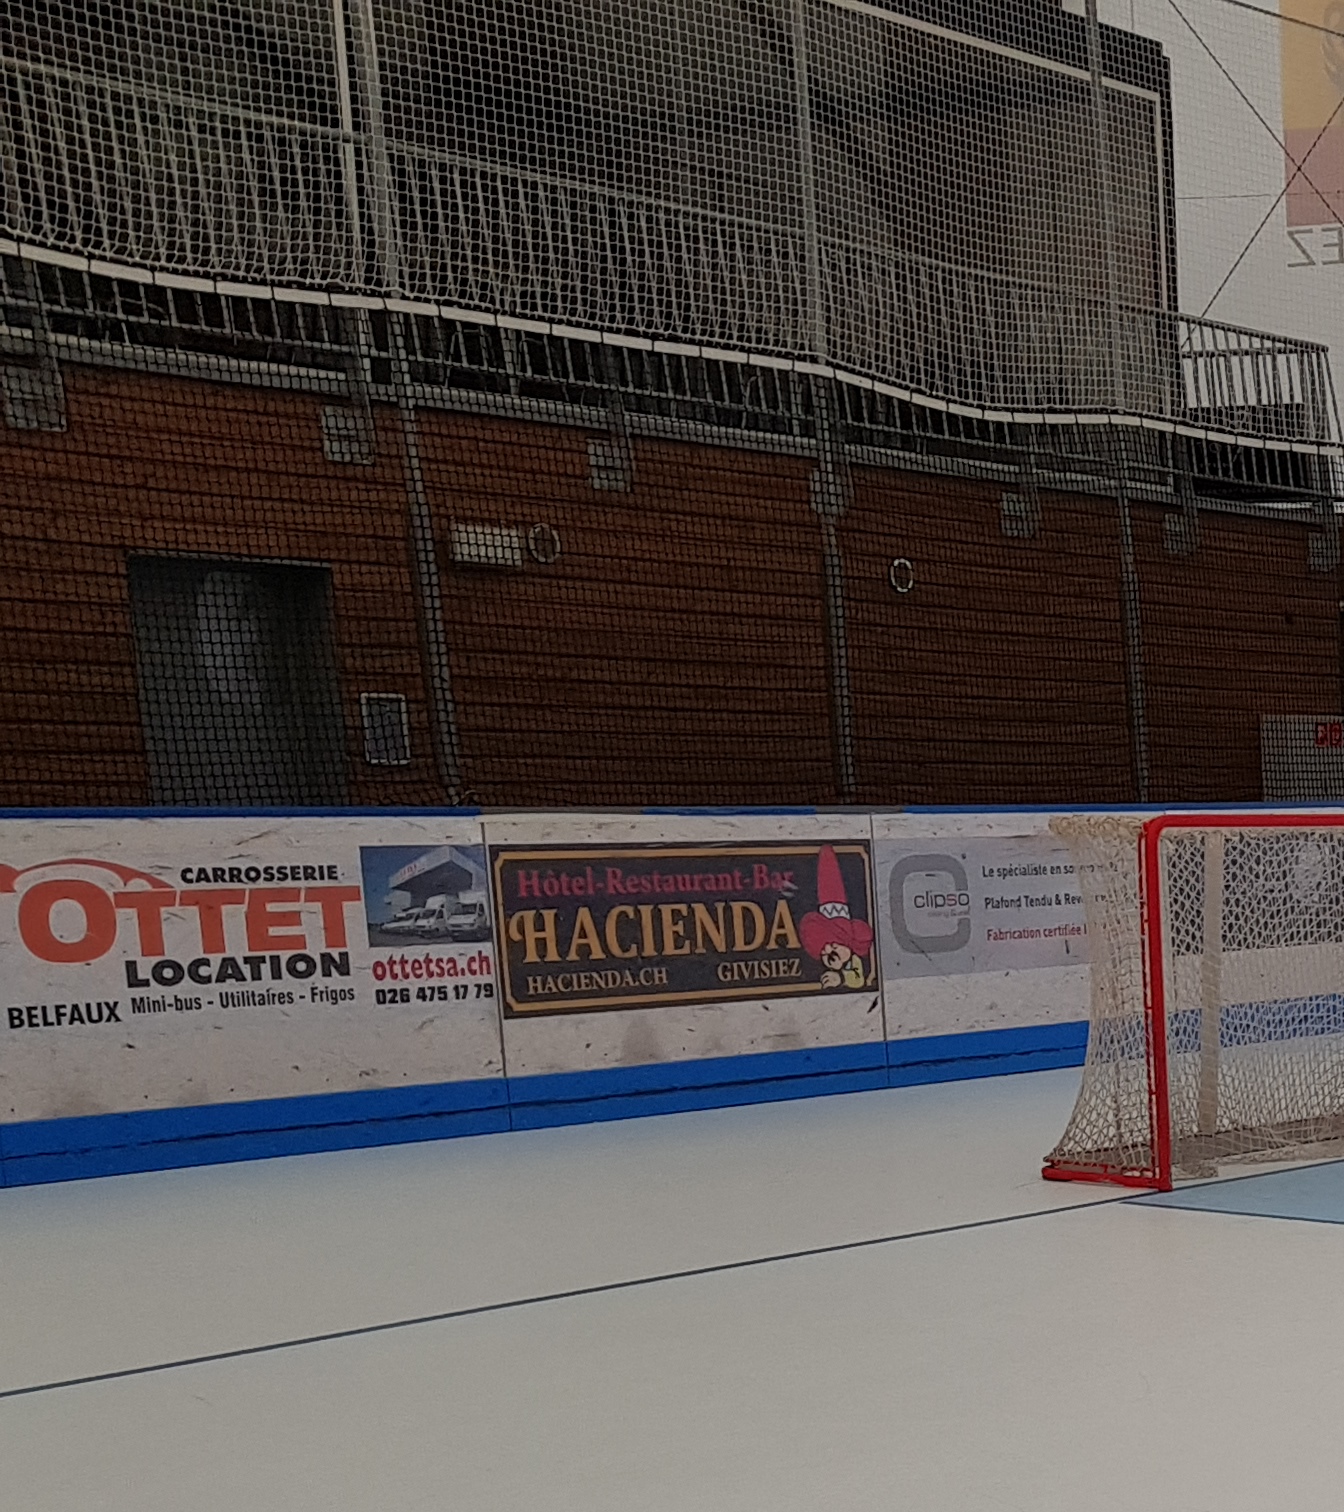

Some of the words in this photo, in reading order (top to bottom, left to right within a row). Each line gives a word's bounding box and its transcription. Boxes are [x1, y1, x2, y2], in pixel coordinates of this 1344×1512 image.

[180, 864, 338, 886] CARROSSERIE
[982, 865, 994, 878] Le
[997, 863, 1048, 880] spécialiste
[1050, 865, 1062, 875] en
[914, 890, 970, 909] clipso
[984, 896, 1022, 909] Plafond
[1023, 894, 1053, 908] Tendu
[18, 879, 361, 963] OTTET
[508, 899, 802, 964] HACIENDA
[986, 927, 1041, 941] Fabrication
[1042, 923, 1081, 938] certifiée
[125, 950, 351, 988] LOCATION
[372, 950, 492, 981] ottetsa.ch
[717, 958, 802, 982] GIVISIEZ
[130, 992, 202, 1015] Mini-bus
[219, 987, 295, 1010] Utilitaires
[310, 984, 356, 1005] Frigos
[376, 988, 410, 1005] 026
[416, 985, 448, 1002] 475
[453, 984, 468, 999] 17
[474, 983, 494, 999] 79
[7, 1001, 121, 1029] BELFAUX
